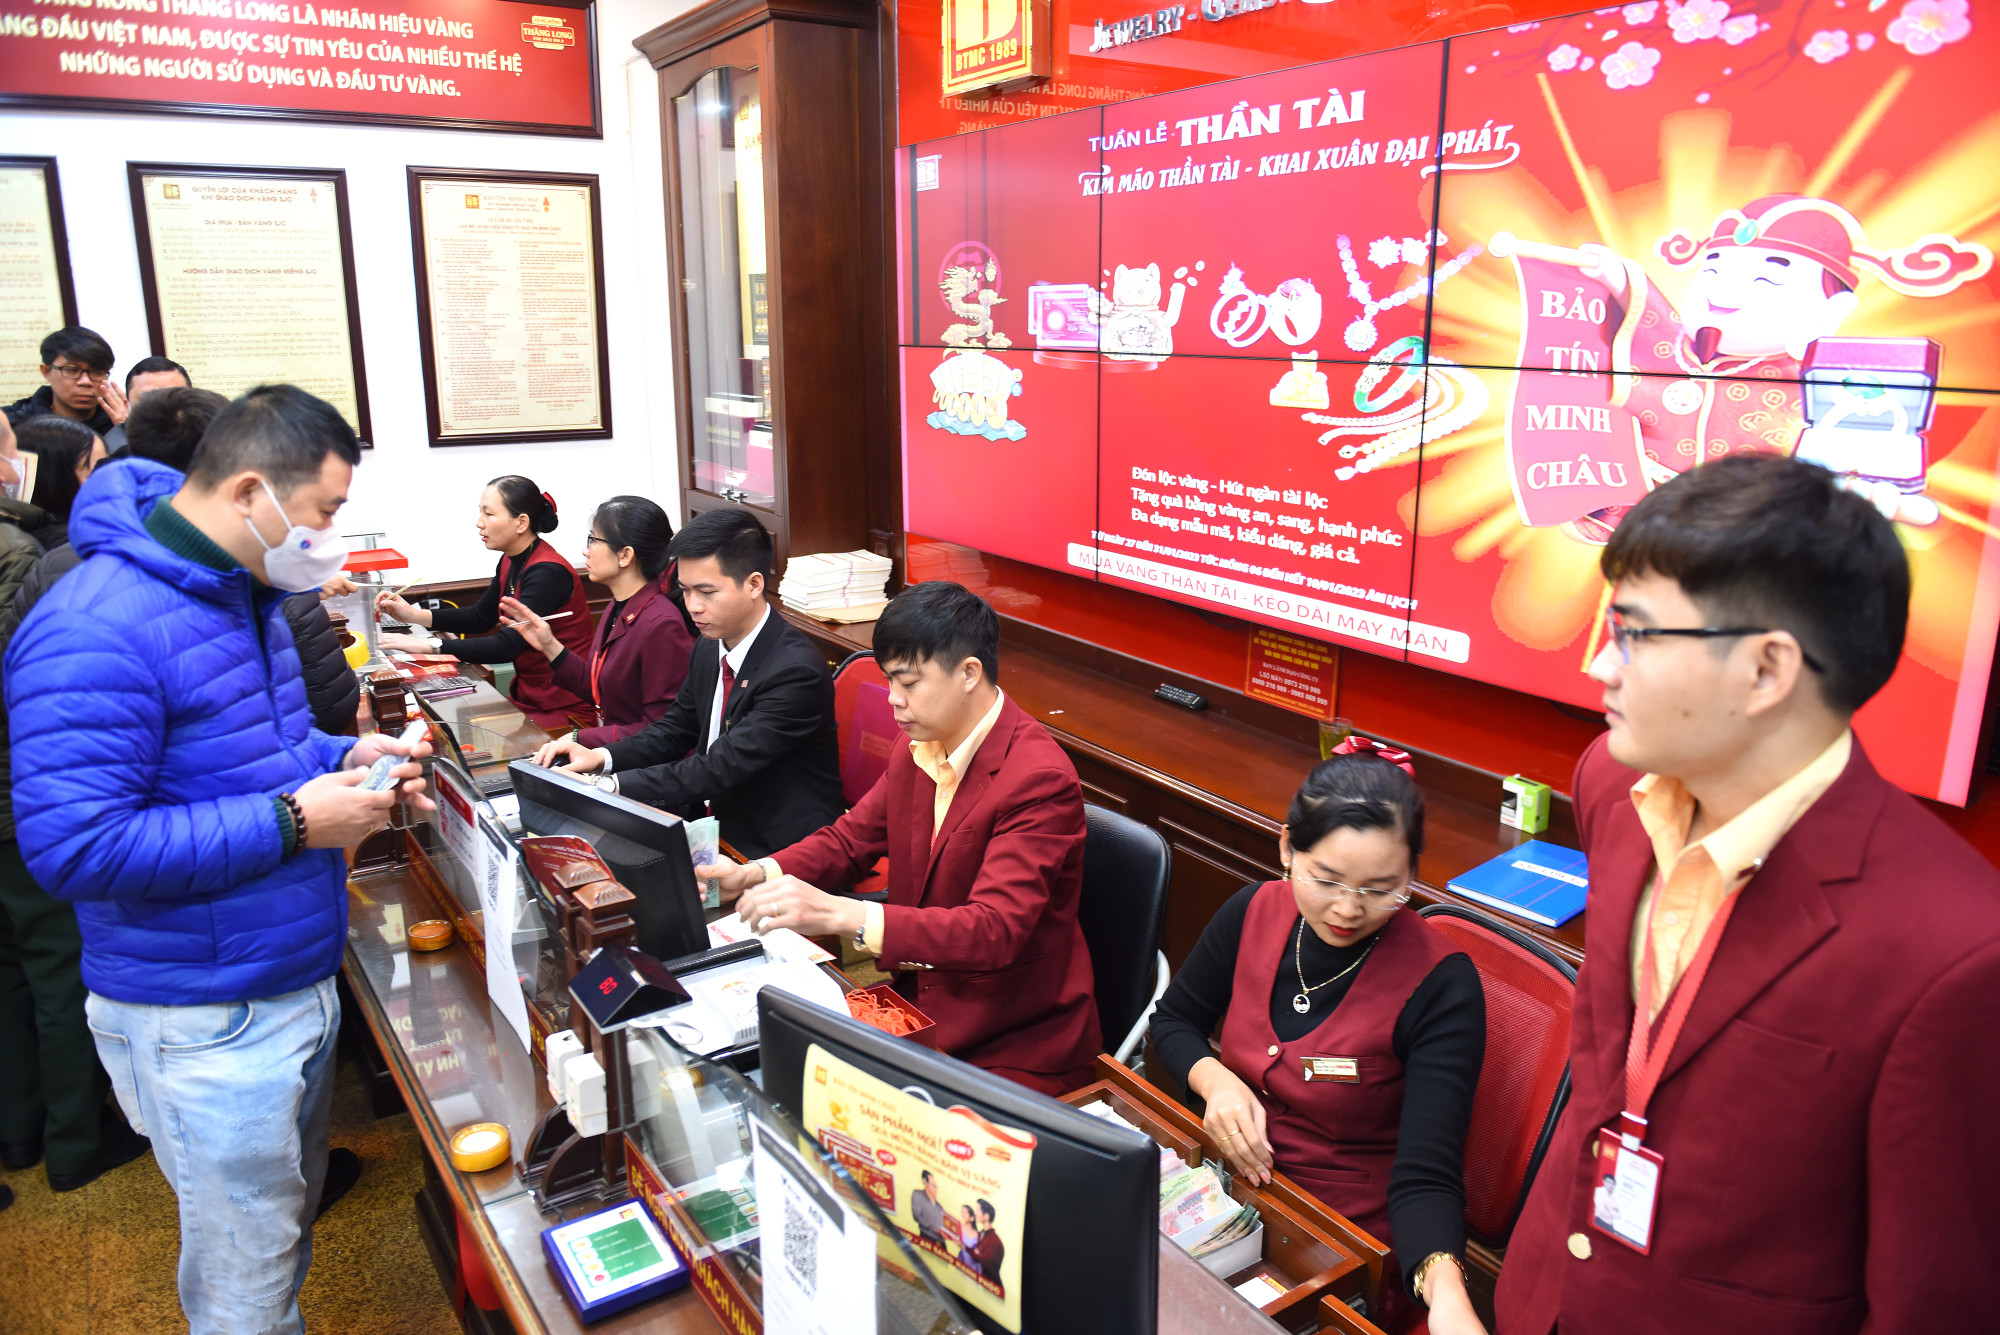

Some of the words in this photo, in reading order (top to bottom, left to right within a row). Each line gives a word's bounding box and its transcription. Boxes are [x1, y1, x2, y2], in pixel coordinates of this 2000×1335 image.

[234, 1, 291, 23] LONG
[292, 3, 319, 25] LÀ
[320, 7, 379, 30] NHÃN
[379, 12, 422, 38] HIỆU
[422, 16, 474, 40] VÀNG
[551, 30, 573, 39] LONG
[1089, 4, 1185, 53] JEWELRY
[0, 13, 39, 38] NG
[41, 12, 89, 40] ĐẦU
[91, 18, 138, 47] VIỆT
[141, 24, 198, 51] NAM,
[199, 28, 262, 55] ĐƯỢC
[262, 33, 290, 59] SỰ
[291, 37, 326, 57] TIN
[326, 37, 363, 60] YÊU
[366, 39, 404, 63] CỦA
[406, 45, 461, 68] NHIỀU
[463, 49, 498, 71] THẾ
[499, 52, 523, 77] HỆ
[955, 46, 986, 72] BTMC
[989, 37, 1018, 62] 1989
[59, 50, 141, 77] NHỮNG
[143, 57, 214, 81] NGƯỜI
[215, 58, 243, 82] SỬ
[247, 64, 306, 89] DỤNG
[306, 66, 334, 88] VÀ
[335, 68, 377, 91] ĐẦU
[377, 73, 404, 92] TƯ
[404, 74, 462, 97] VÀNG.
[1088, 128, 1141, 152] TUẦN
[1144, 120, 1168, 145] LỄ
[1174, 100, 1282, 147] THẦN
[1292, 87, 1366, 130] TÀI
[1080, 170, 1114, 197] KIM
[1117, 167, 1155, 193] MÃO
[1158, 156, 1206, 188] THẦN
[1210, 155, 1241, 183] TÀI
[1257, 150, 1311, 178] KHAI
[1313, 138, 1380, 171] XUÂN
[1384, 136, 1430, 167] ĐẠI
[1436, 119, 1519, 160] PHÁT
[1539, 286, 1607, 325] BẢO
[1544, 340, 1600, 380] TÍN
[1525, 404, 1613, 434] MINH
[1131, 466, 1157, 483] Đón
[1158, 469, 1177, 487] lộc
[1178, 474, 1209, 494] vàng
[1219, 479, 1245, 496] Hút
[1246, 485, 1281, 503] ngàn
[1282, 489, 1302, 505] tài
[1305, 490, 1329, 510] lộc
[1526, 454, 1628, 491] CHÂU
[1130, 487, 1160, 507] Tặng
[1160, 494, 1184, 509] quà
[1185, 494, 1217, 517] bằng
[1217, 502, 1251, 523] vàng
[1252, 510, 1275, 527] an,
[1276, 514, 1315, 535] sang,
[1317, 516, 1358, 539] hạnh
[1360, 525, 1403, 547] phúc
[1131, 507, 1149, 523] Đa
[1150, 511, 1180, 532] dạng
[1180, 517, 1208, 534] mẫu
[1210, 525, 1234, 542] mã,
[1236, 526, 1266, 546] kiểu
[1267, 532, 1307, 556] dáng,
[1309, 542, 1334, 560] giá
[1336, 546, 1361, 564] cả.
[1079, 552, 1112, 570] MUA
[1116, 560, 1158, 581] VÀNG
[1211, 583, 1237, 601] TÀI
[1253, 593, 1291, 613] KÉO
[1296, 604, 1331, 624] DÀI
[1337, 614, 1384, 636] MAY
[1284, 572, 1306, 586] HẾT
[1365, 588, 1387, 604] ÂM
[691, 1252, 730, 1316] KHÁCH
